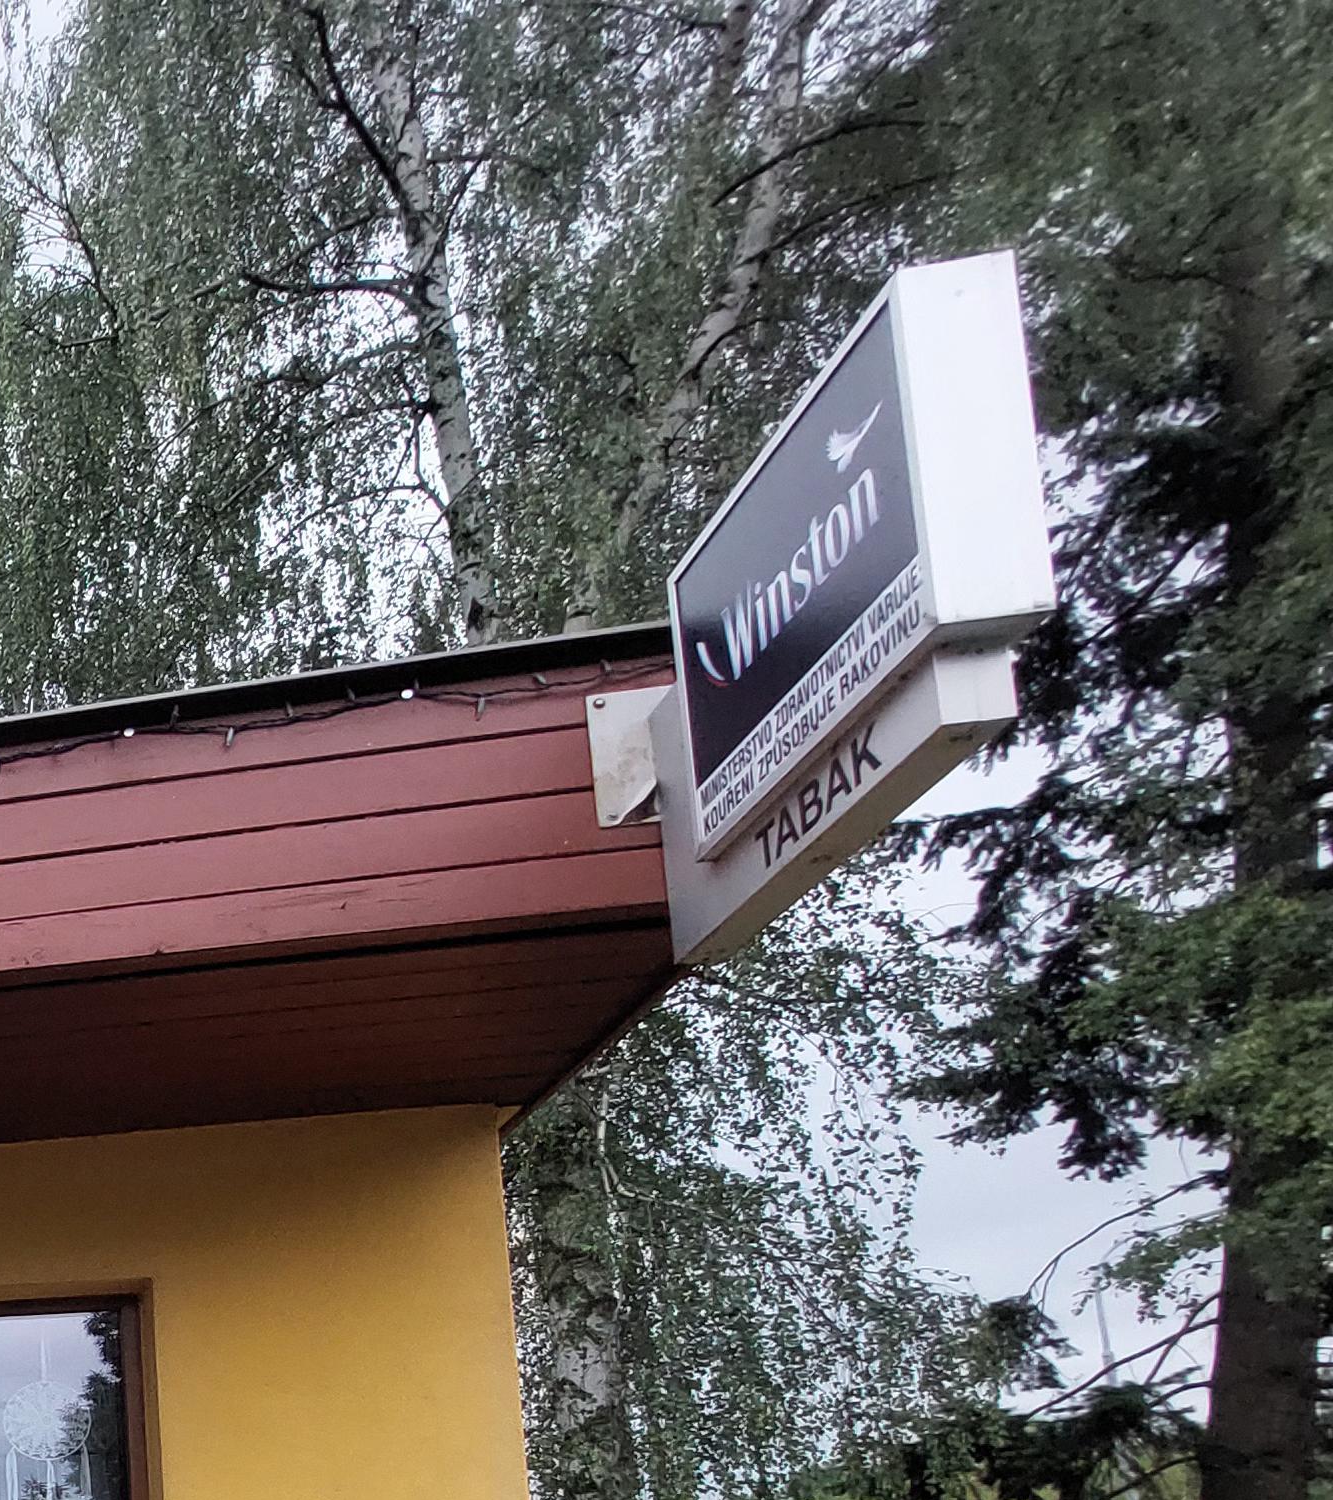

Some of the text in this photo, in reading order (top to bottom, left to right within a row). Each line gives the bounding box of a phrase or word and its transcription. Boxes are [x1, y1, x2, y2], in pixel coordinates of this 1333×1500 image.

[696, 468, 880, 682] Winston
[699, 724, 773, 810] MINISTERSTVO
[775, 616, 865, 731] ZDRAVOTNICTVÍ
[703, 775, 755, 836] KOUŘENÍ
[758, 690, 836, 783] ZPŮSOBUJE
